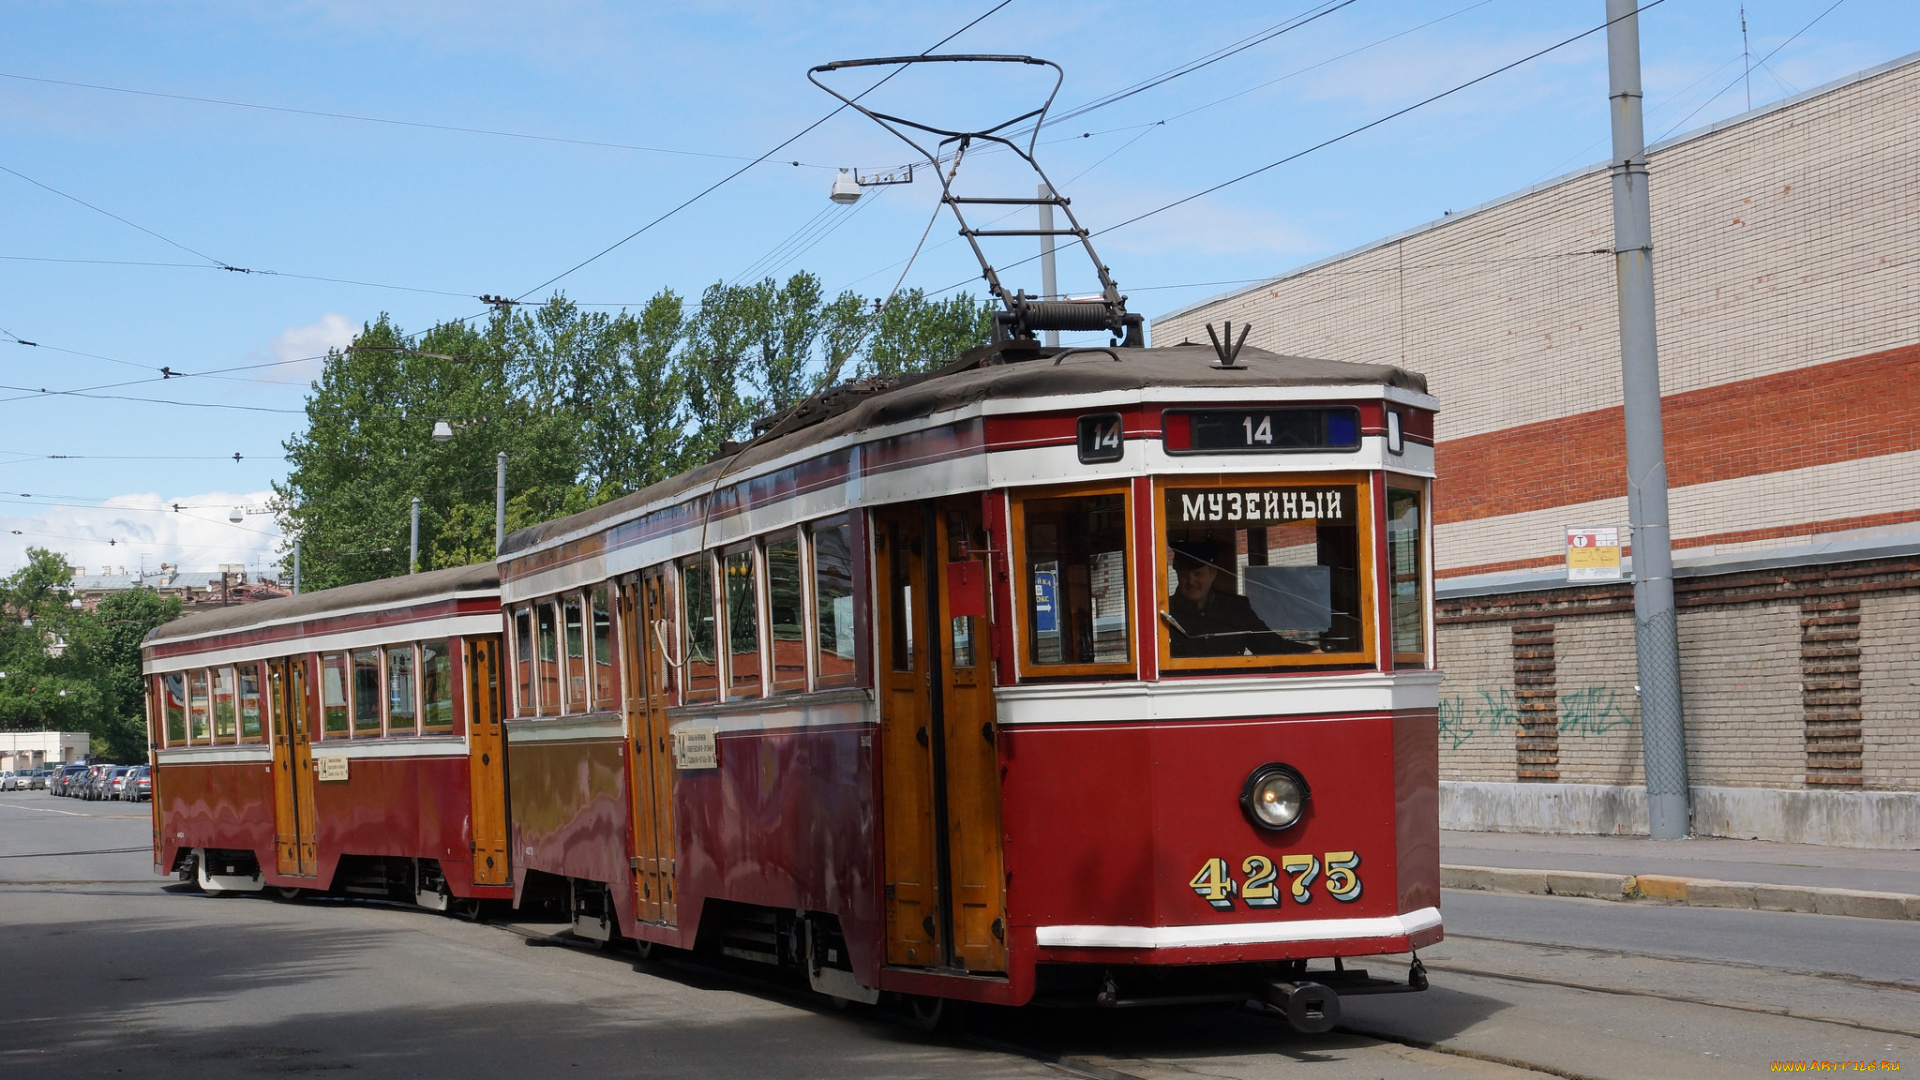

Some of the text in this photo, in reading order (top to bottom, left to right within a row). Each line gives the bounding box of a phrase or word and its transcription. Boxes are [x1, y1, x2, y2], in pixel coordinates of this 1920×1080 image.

[1093, 421, 1119, 451] 14
[1242, 415, 1273, 445] 14
[1182, 490, 1342, 522] МУЗЕЙНЫЙ
[1189, 850, 1363, 911] 4275
